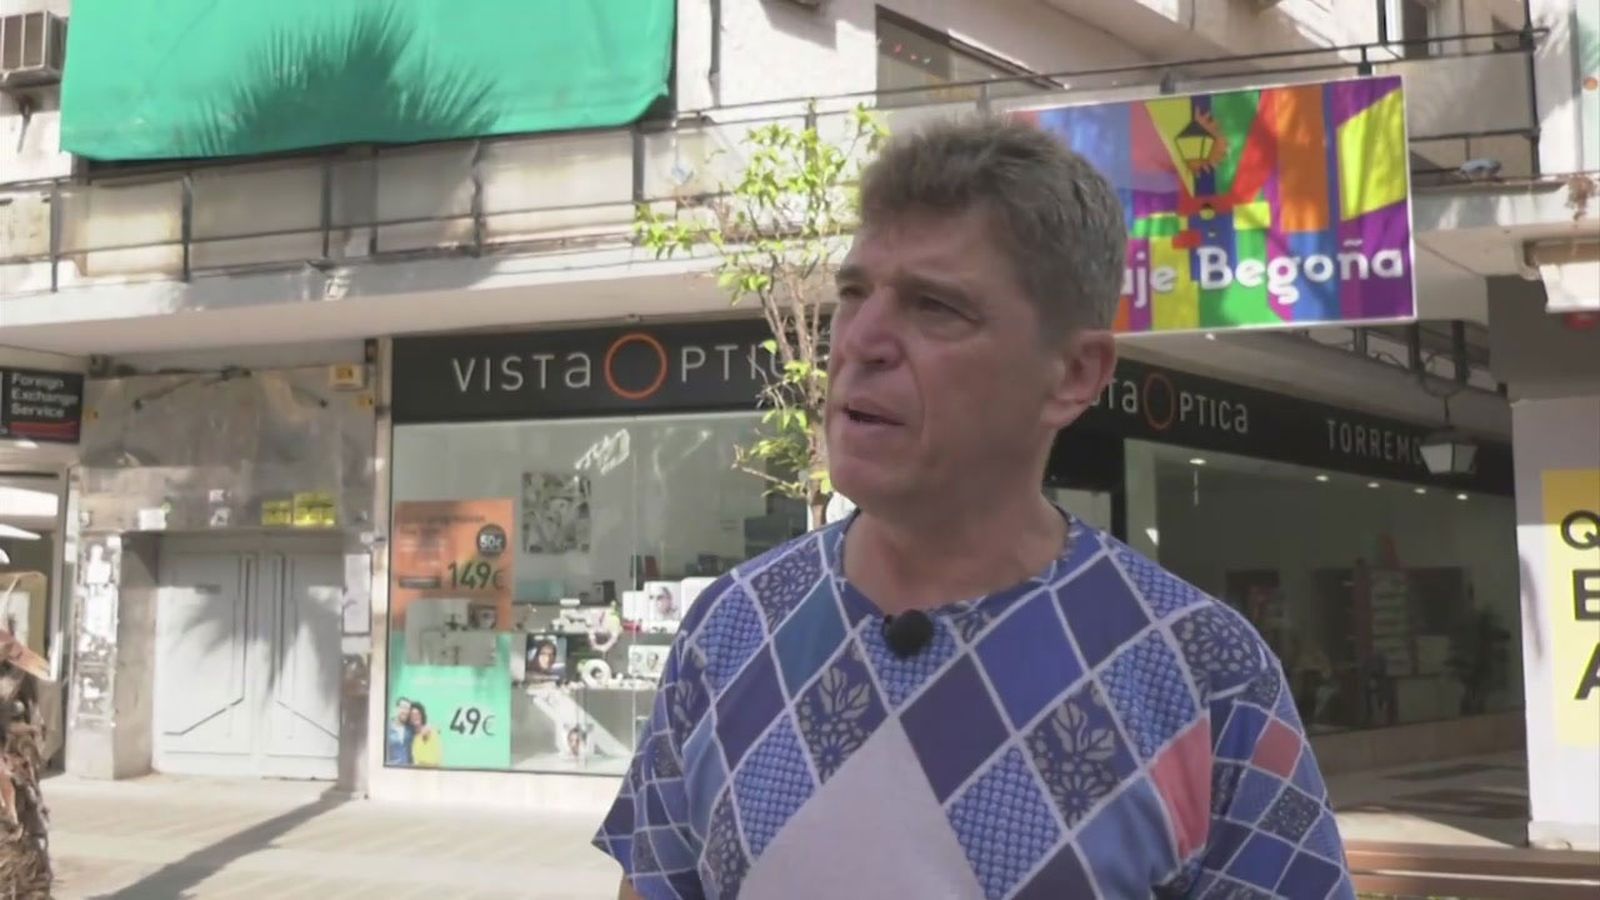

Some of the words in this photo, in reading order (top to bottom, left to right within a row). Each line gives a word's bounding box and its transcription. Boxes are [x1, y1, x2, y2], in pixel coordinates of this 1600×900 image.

[1197, 239, 1404, 305] Begoña
[11, 373, 64, 391] Foreign
[11, 388, 79, 406] Exchange
[11, 403, 64, 418] Service
[450, 707, 496, 736] 49€
